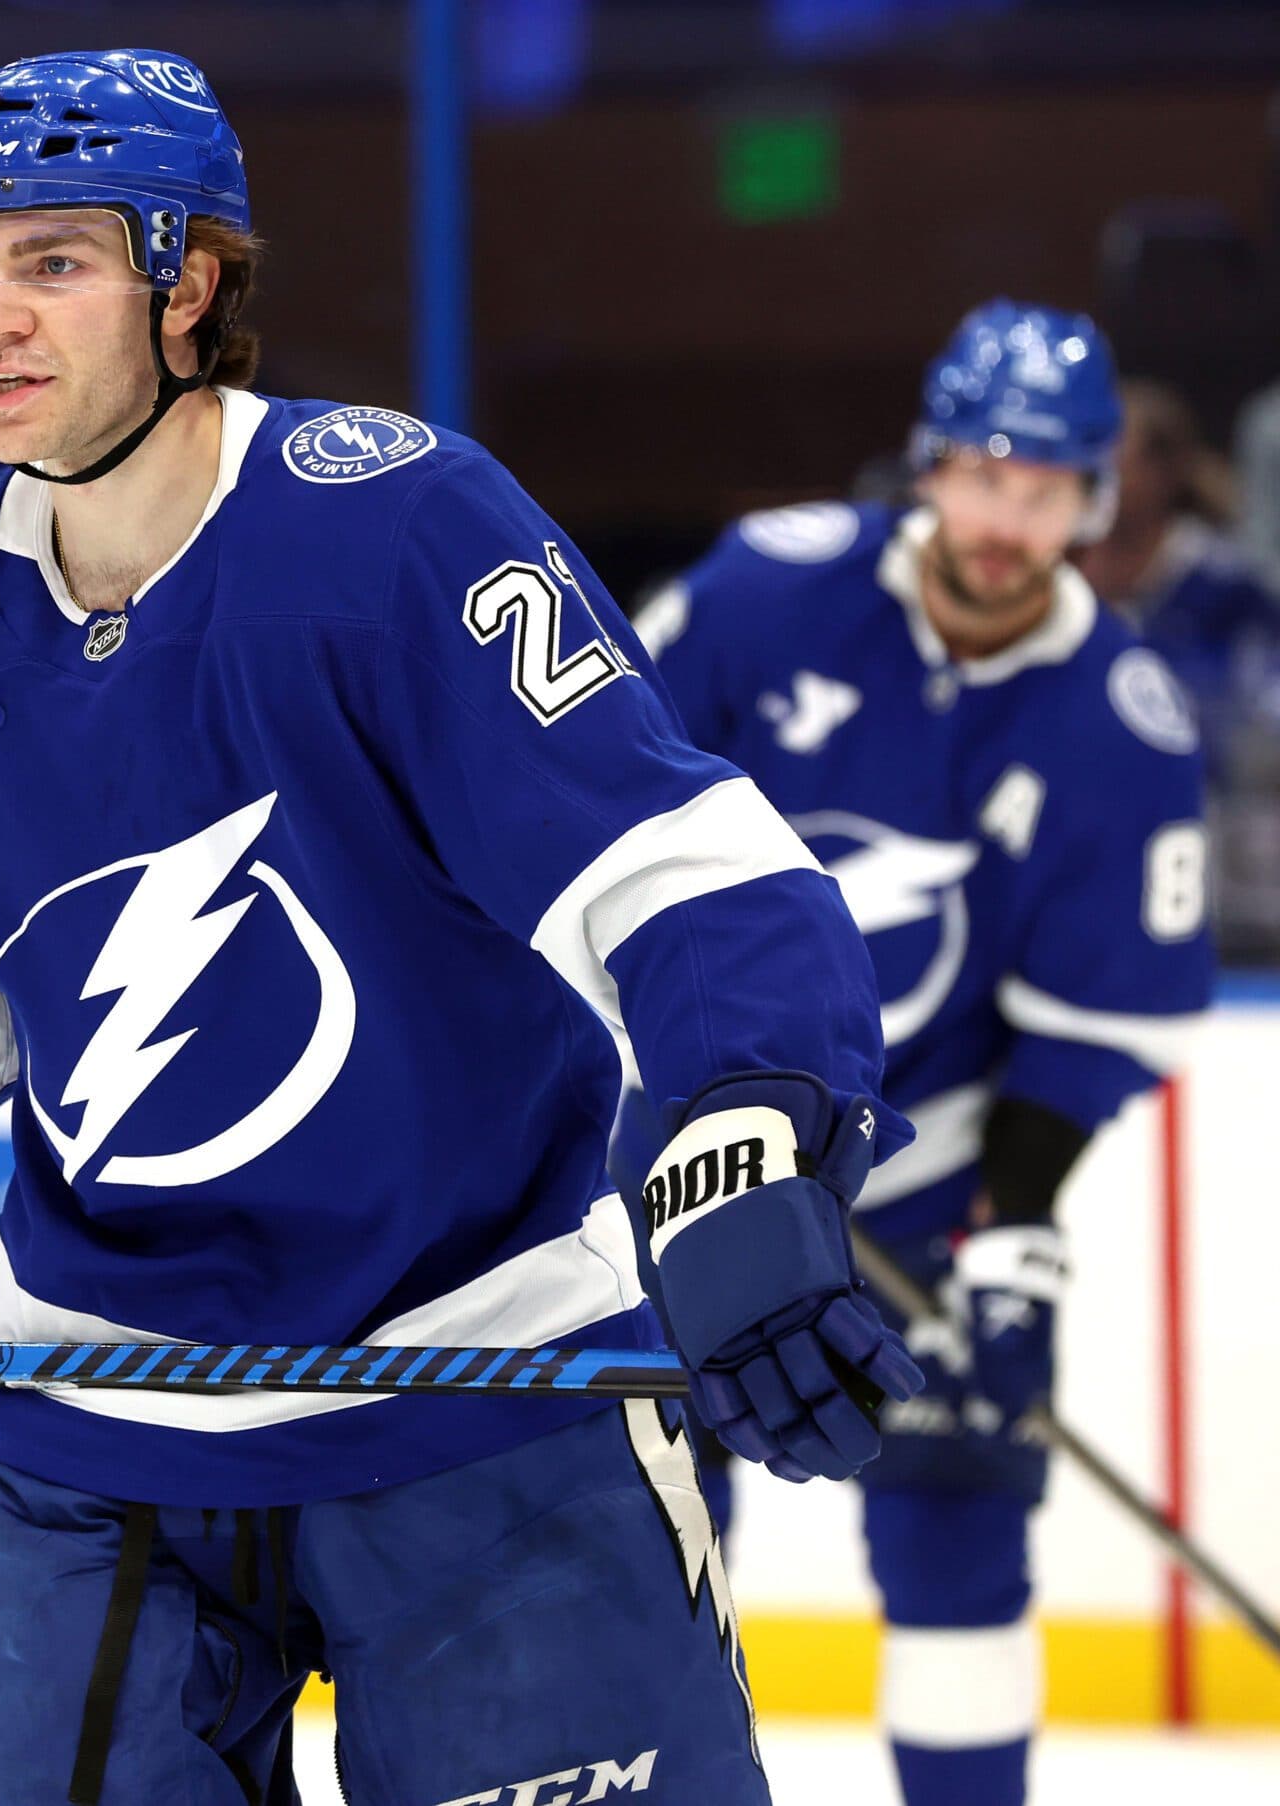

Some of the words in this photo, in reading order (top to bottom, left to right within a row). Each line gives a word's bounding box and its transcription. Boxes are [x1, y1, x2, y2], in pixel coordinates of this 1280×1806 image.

[310, 410, 420, 434] LIGHTNING
[294, 432, 313, 454] BAY
[301, 454, 366, 475] TAMPA
[93, 626, 120, 654] NHL
[979, 763, 1046, 861] A
[643, 1138, 765, 1241] RIOR
